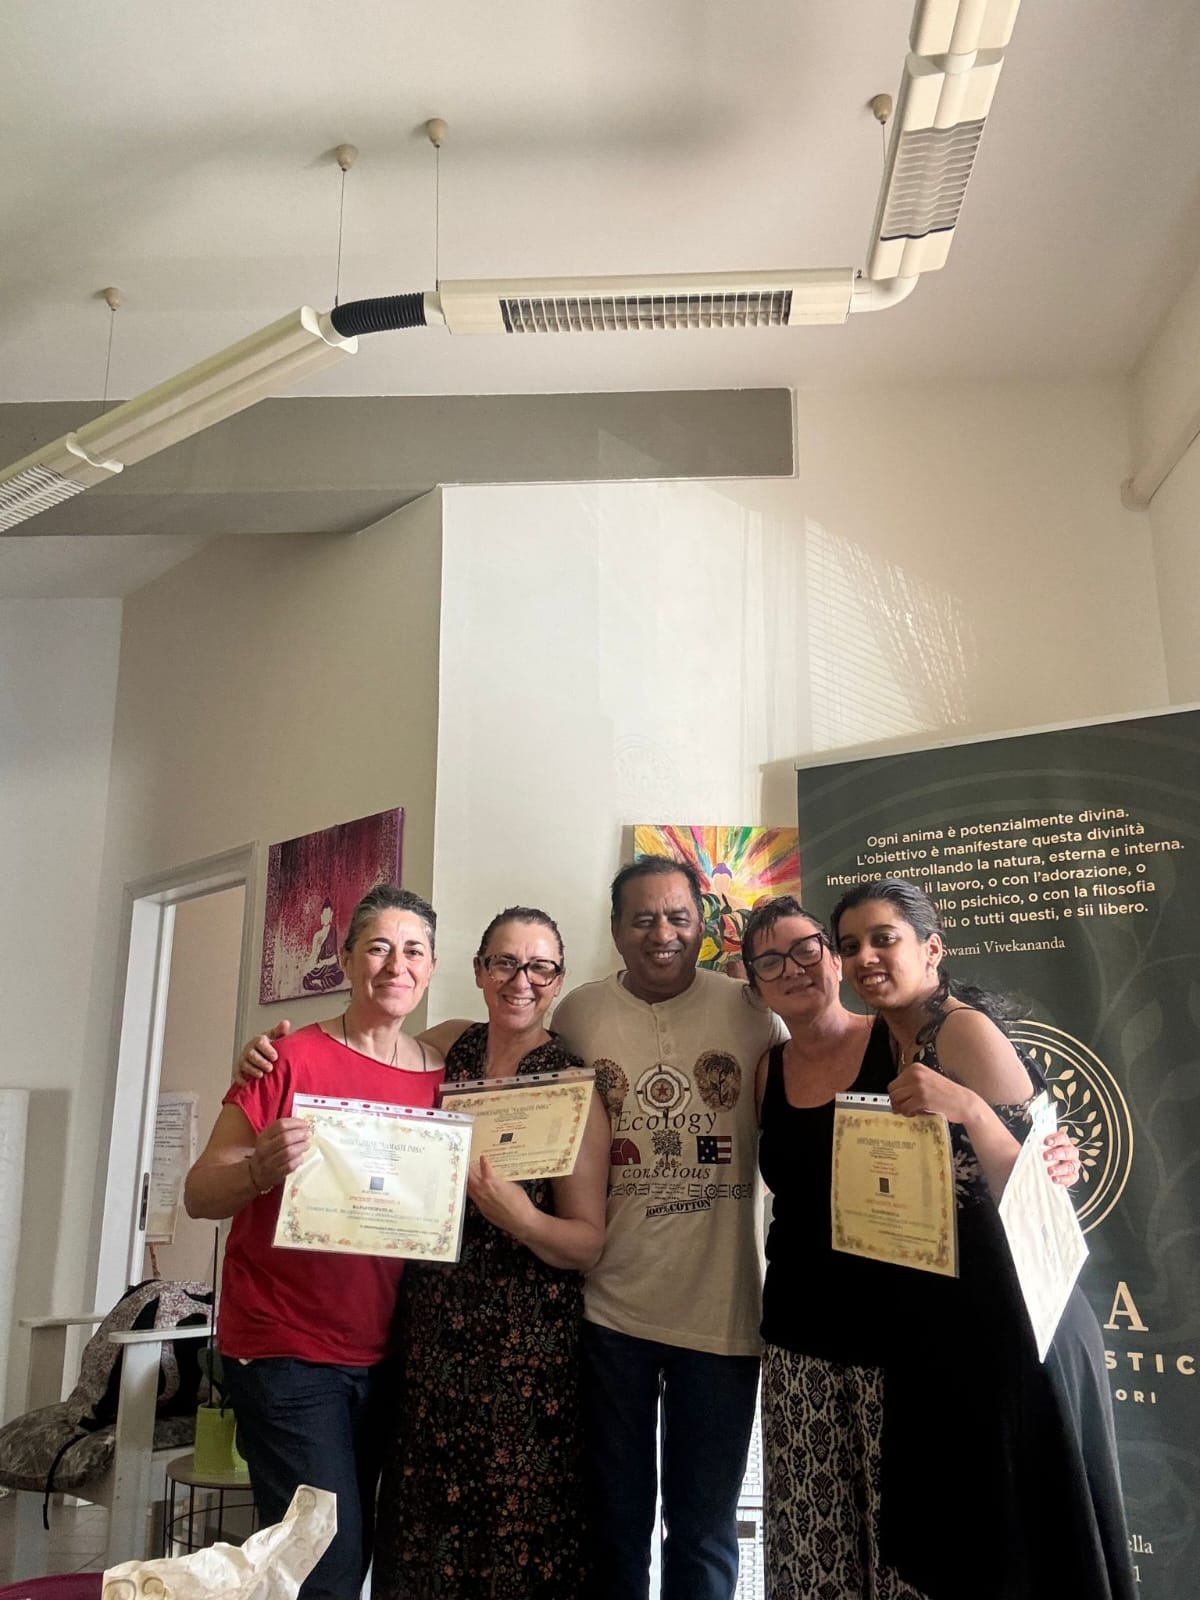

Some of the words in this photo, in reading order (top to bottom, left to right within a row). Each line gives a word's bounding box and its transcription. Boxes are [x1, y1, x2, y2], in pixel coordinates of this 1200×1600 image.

[867, 833, 898, 847] Ogni
[902, 829, 943, 843] anima
[947, 826, 956, 837] è
[960, 812, 1074, 837] potenzialmente
[1078, 808, 1129, 823] divina.
[856, 850, 927, 866] L'obiettivo
[931, 846, 939, 857] è
[943, 837, 1027, 856] manifestare
[1031, 831, 1082, 848] questa
[1087, 822, 1145, 841] divinità
[826, 872, 882, 886] interiore
[885, 863, 973, 880] controllando
[977, 858, 989, 870] la
[993, 856, 1045, 869] natura,
[1048, 848, 1106, 863] esterna
[1110, 847, 1120, 857] e
[1124, 840, 1185, 856] interna.
[924, 882, 933, 894] il
[936, 880, 984, 893] lavoro,
[988, 877, 998, 888] o
[1001, 873, 1029, 886] con
[1033, 865, 1132, 884] l'adorazione,
[1135, 863, 1146, 874] o
[960, 893, 1025, 911] psichico,
[1028, 893, 1039, 903] o
[1042, 889, 1070, 901] con
[1074, 886, 1088, 898] la
[1092, 880, 1156, 896] filosofia
[943, 916, 957, 929] iù
[960, 917, 970, 927] o
[974, 913, 1005, 925] tutti
[1009, 908, 1060, 924] questi,
[1063, 906, 1073, 917] e
[1076, 904, 1094, 917] sii
[1099, 902, 1149, 915] libero.
[983, 935, 1066, 953] Vivekananda
[616, 1111, 717, 1135] Ecology
[622, 1167, 712, 1180] conscious
